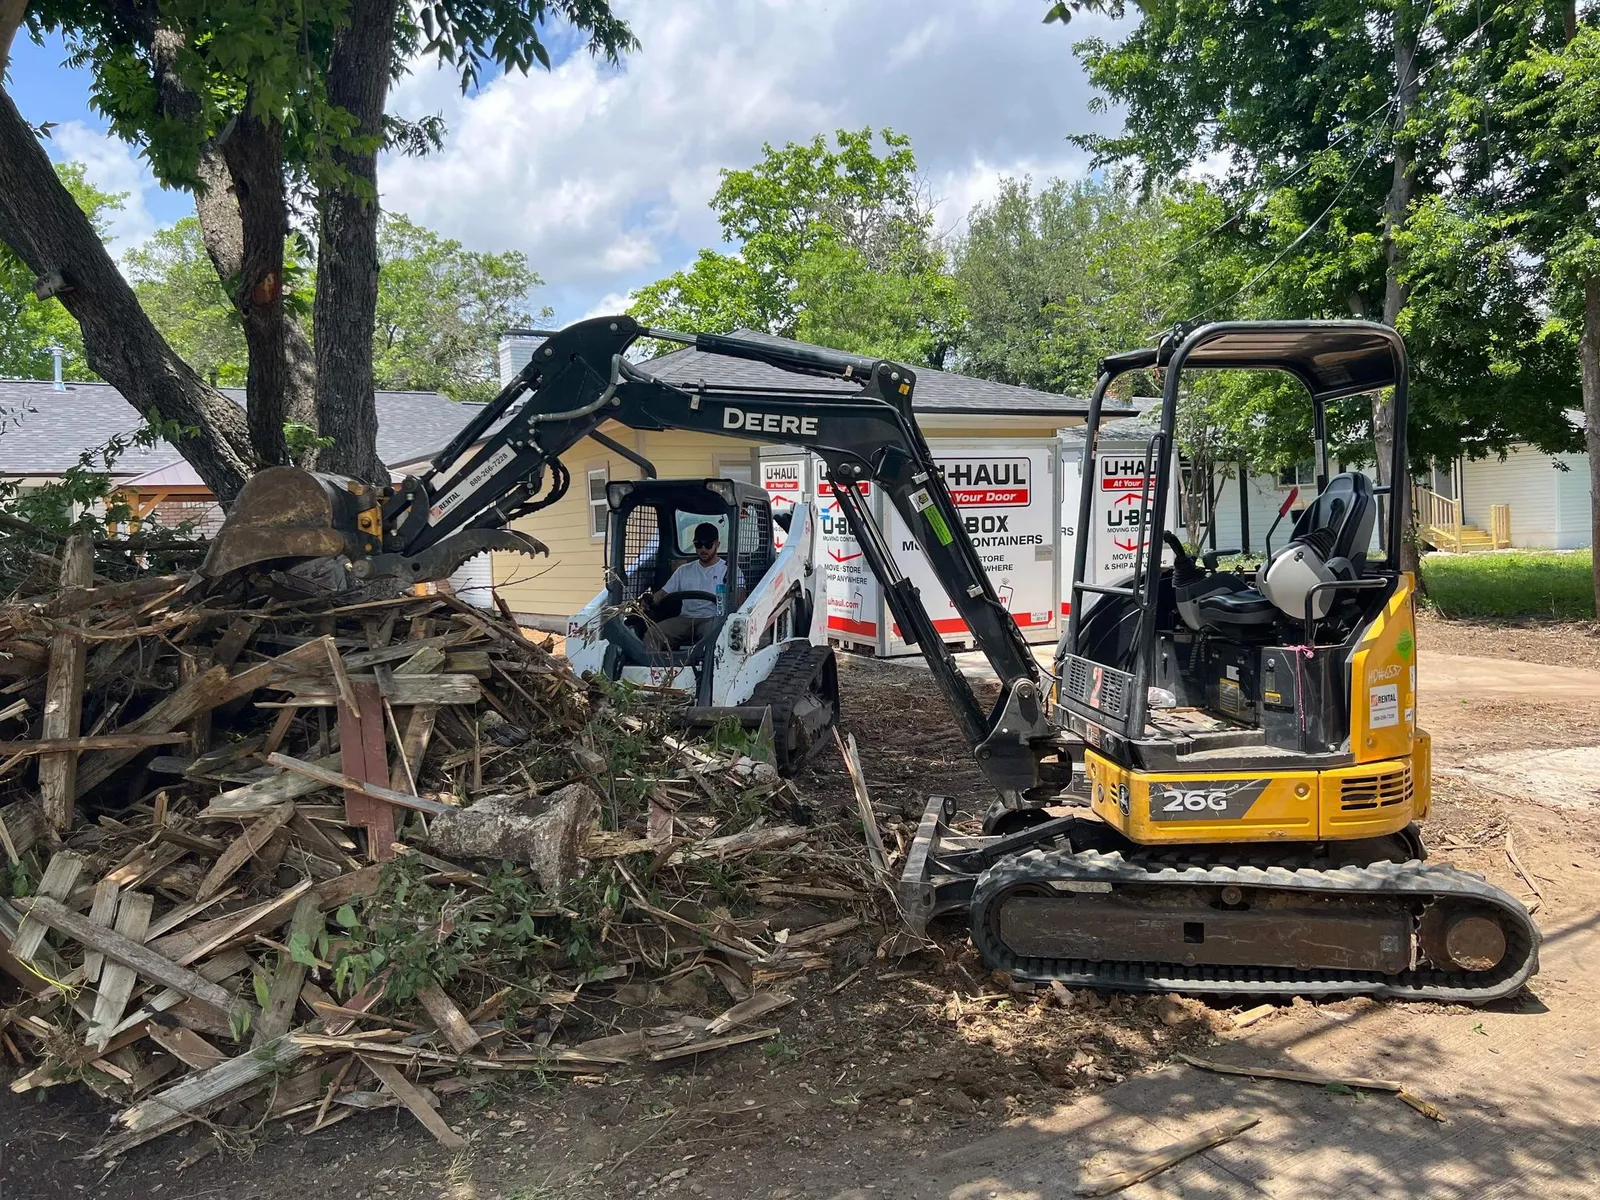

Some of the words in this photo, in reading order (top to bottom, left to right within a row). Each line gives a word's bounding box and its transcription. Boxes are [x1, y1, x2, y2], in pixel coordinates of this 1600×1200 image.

[723, 407, 819, 436] DEERE
[469, 452, 509, 487] 888-266-7228
[766, 467, 798, 479] U-HAUL
[940, 463, 1026, 486] -HAUL
[438, 492, 461, 511] RENTAL
[955, 493, 984, 502] Your
[986, 492, 1016, 501] Door
[972, 534, 1043, 547] ONTAINERS
[837, 576, 867, 585] ANYWHERE
[828, 598, 858, 609] uhaul.com
[1090, 667, 1103, 709] 2
[1377, 694, 1396, 703] RENTAL
[1162, 790, 1227, 812] 26G
